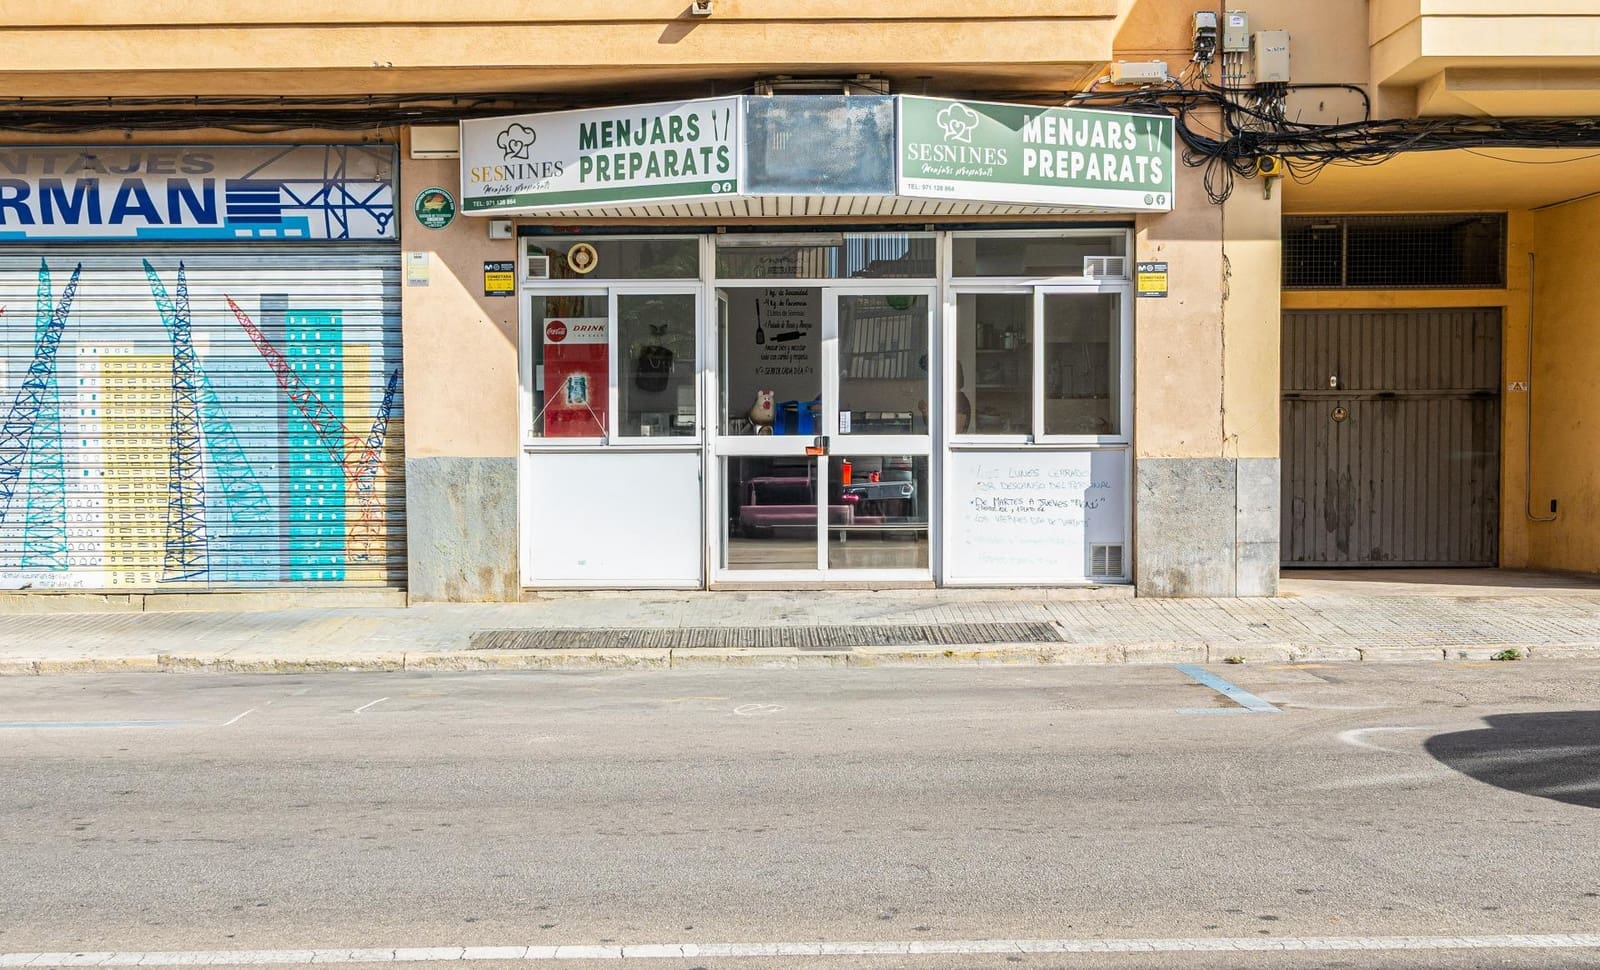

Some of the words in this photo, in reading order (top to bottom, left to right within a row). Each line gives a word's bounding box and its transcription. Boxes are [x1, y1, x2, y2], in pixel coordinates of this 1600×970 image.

[579, 113, 700, 150] MENJARS
[1022, 115, 1136, 150] MENJARS
[471, 160, 564, 183] SESNINES
[579, 145, 730, 183] PREPARATS
[908, 143, 1007, 165] SESNINES
[1022, 149, 1163, 184] PREPARATS
[0, 178, 218, 225] RMAN
